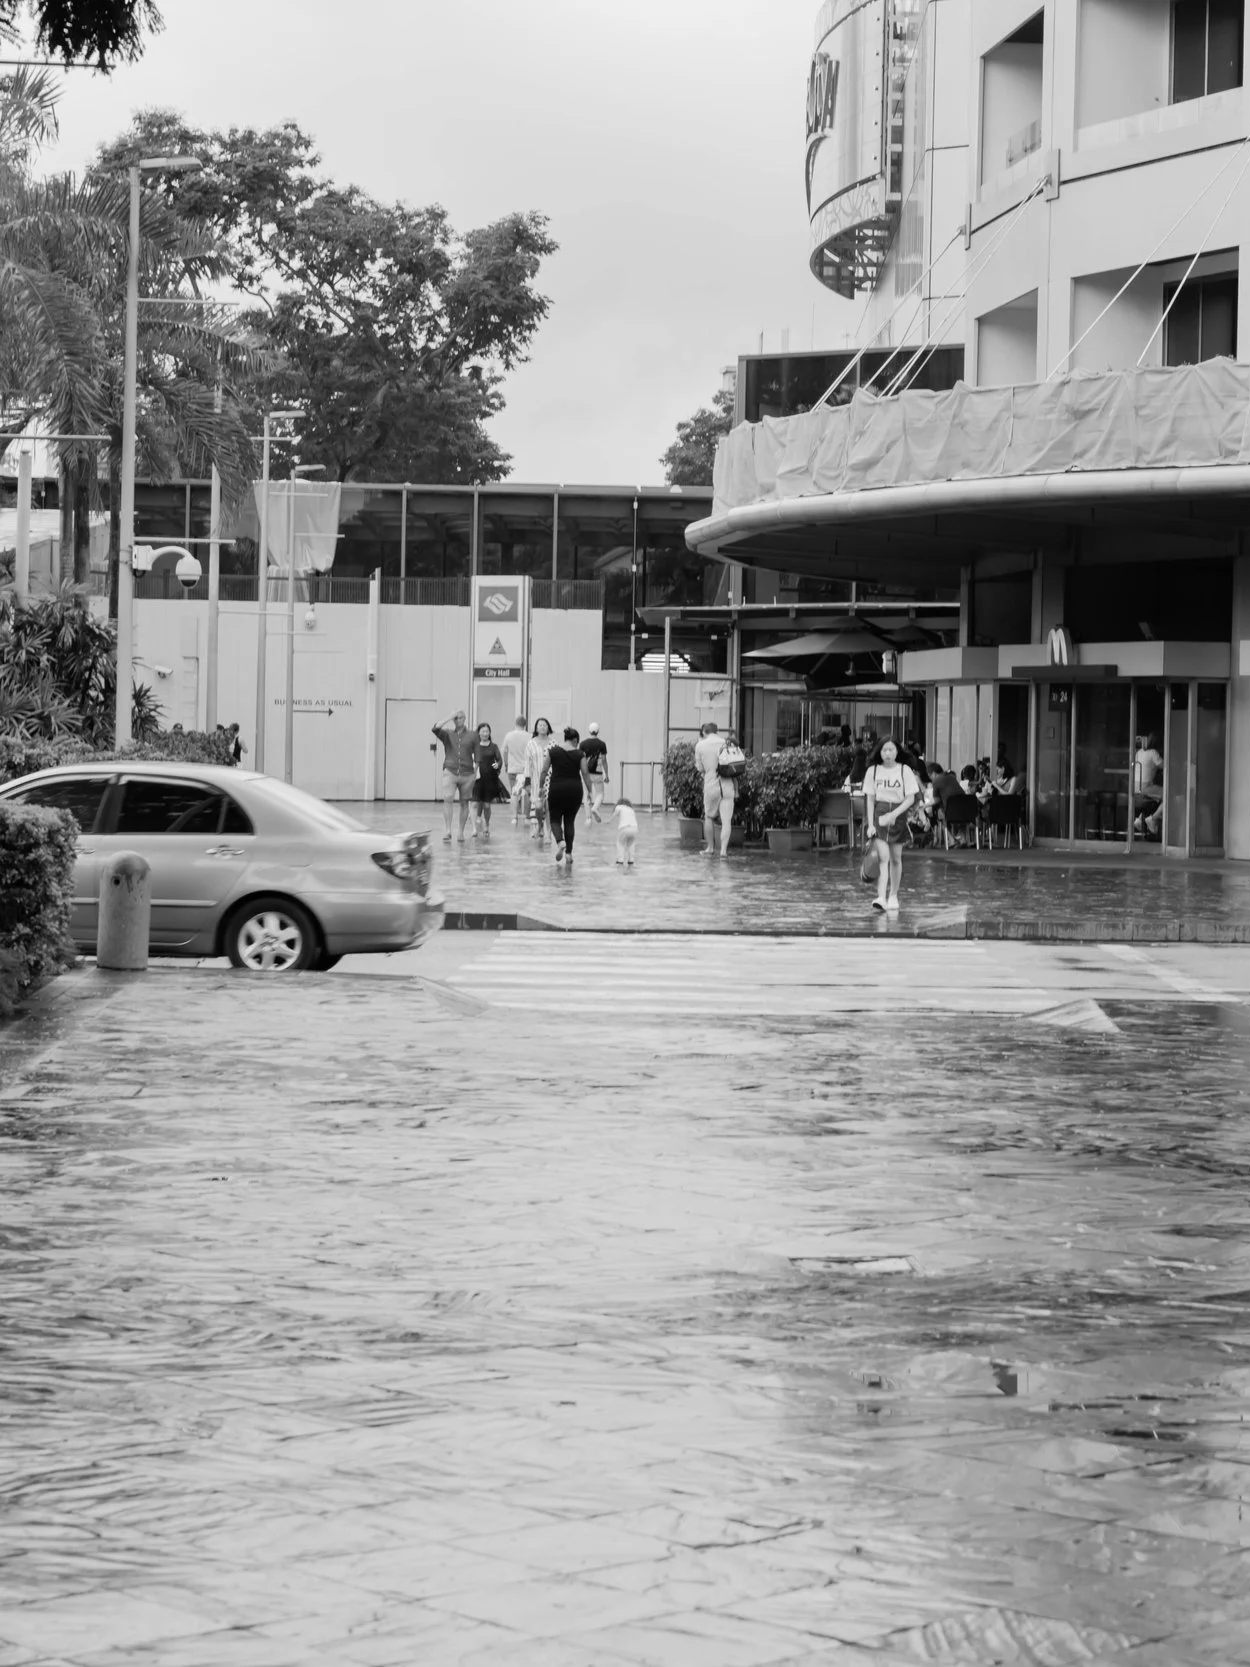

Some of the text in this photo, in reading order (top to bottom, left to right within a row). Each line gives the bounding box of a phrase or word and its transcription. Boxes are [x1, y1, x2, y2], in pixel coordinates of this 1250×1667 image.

[485, 669, 510, 677] City Hall
[329, 699, 352, 707] USUAL
[876, 779, 901, 788] FILA
